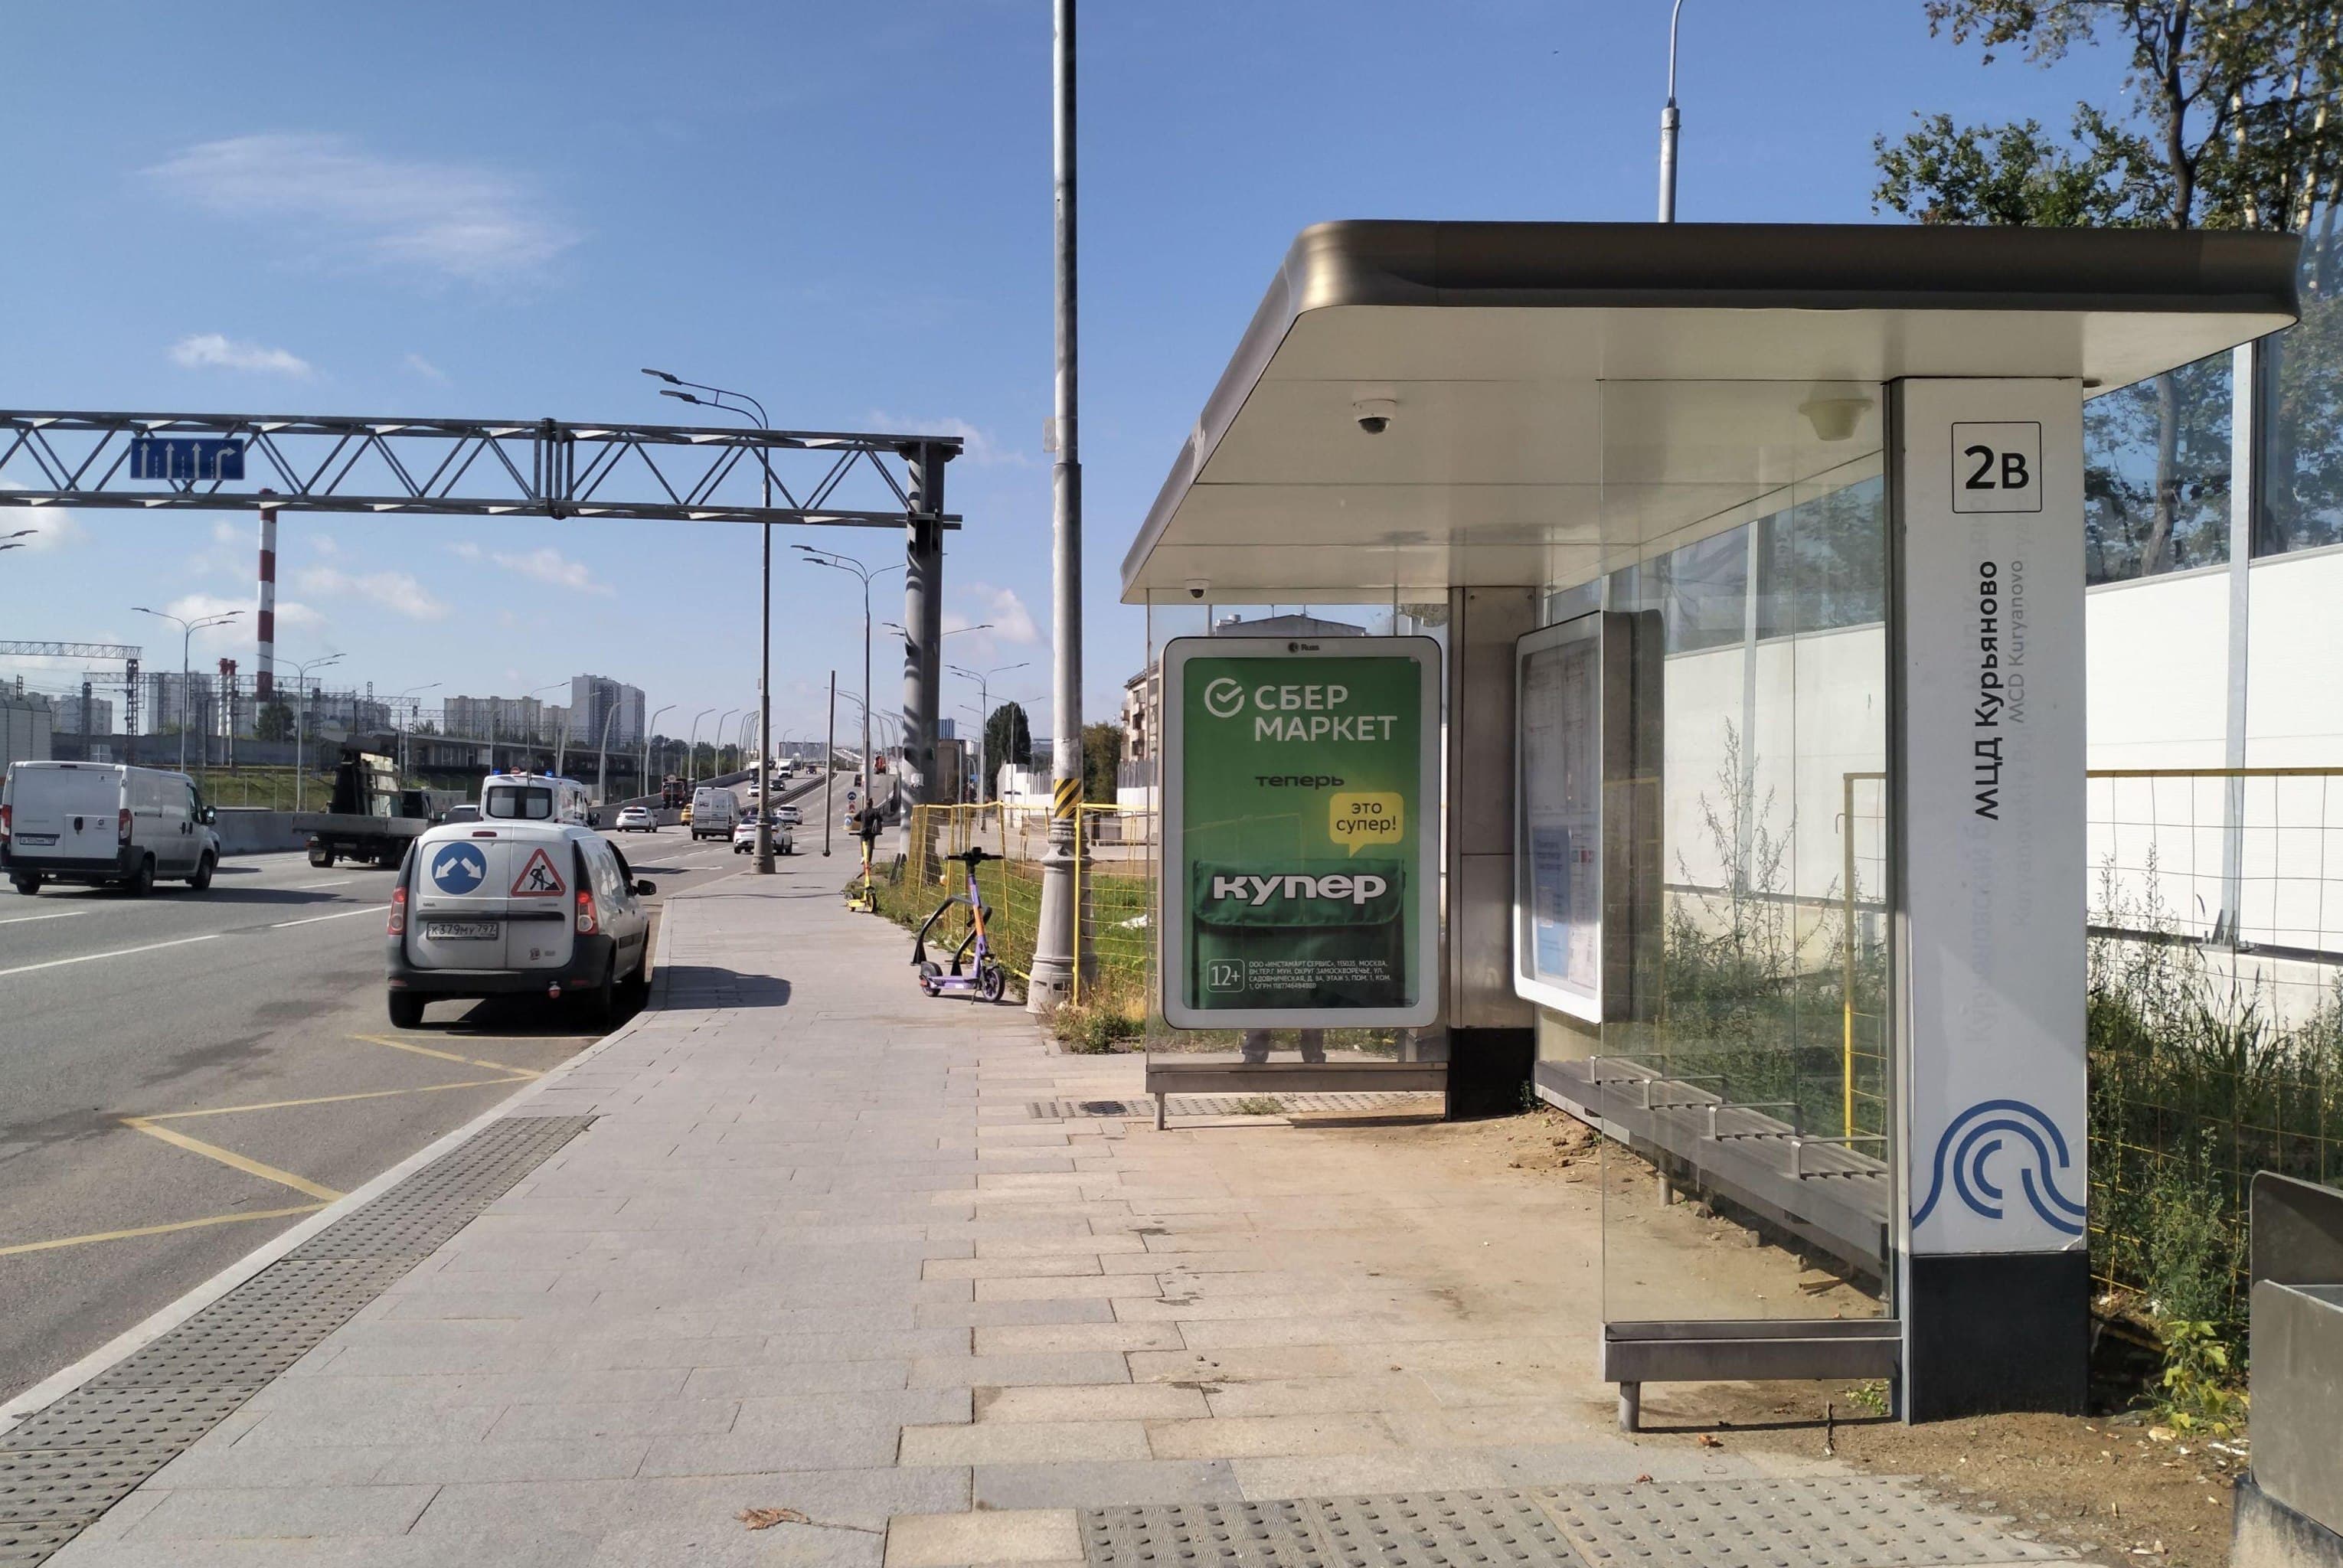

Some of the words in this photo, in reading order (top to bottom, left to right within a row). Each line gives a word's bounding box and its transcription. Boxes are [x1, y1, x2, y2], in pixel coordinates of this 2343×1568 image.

[2008, 560, 2028, 666] Kuryanovo
[1975, 560, 2005, 727] Курьяново
[1254, 685, 1348, 710] СБЕР
[2008, 672, 2025, 724] MCD
[1254, 715, 1397, 741] МАРКЕТ
[1255, 775, 1345, 789] теперь
[1975, 737, 2003, 821] МЦД
[1351, 802, 1382, 815] это
[1336, 816, 1397, 835] супер!
[1213, 874, 1387, 906] купер
[1211, 965, 1240, 987] 12+
